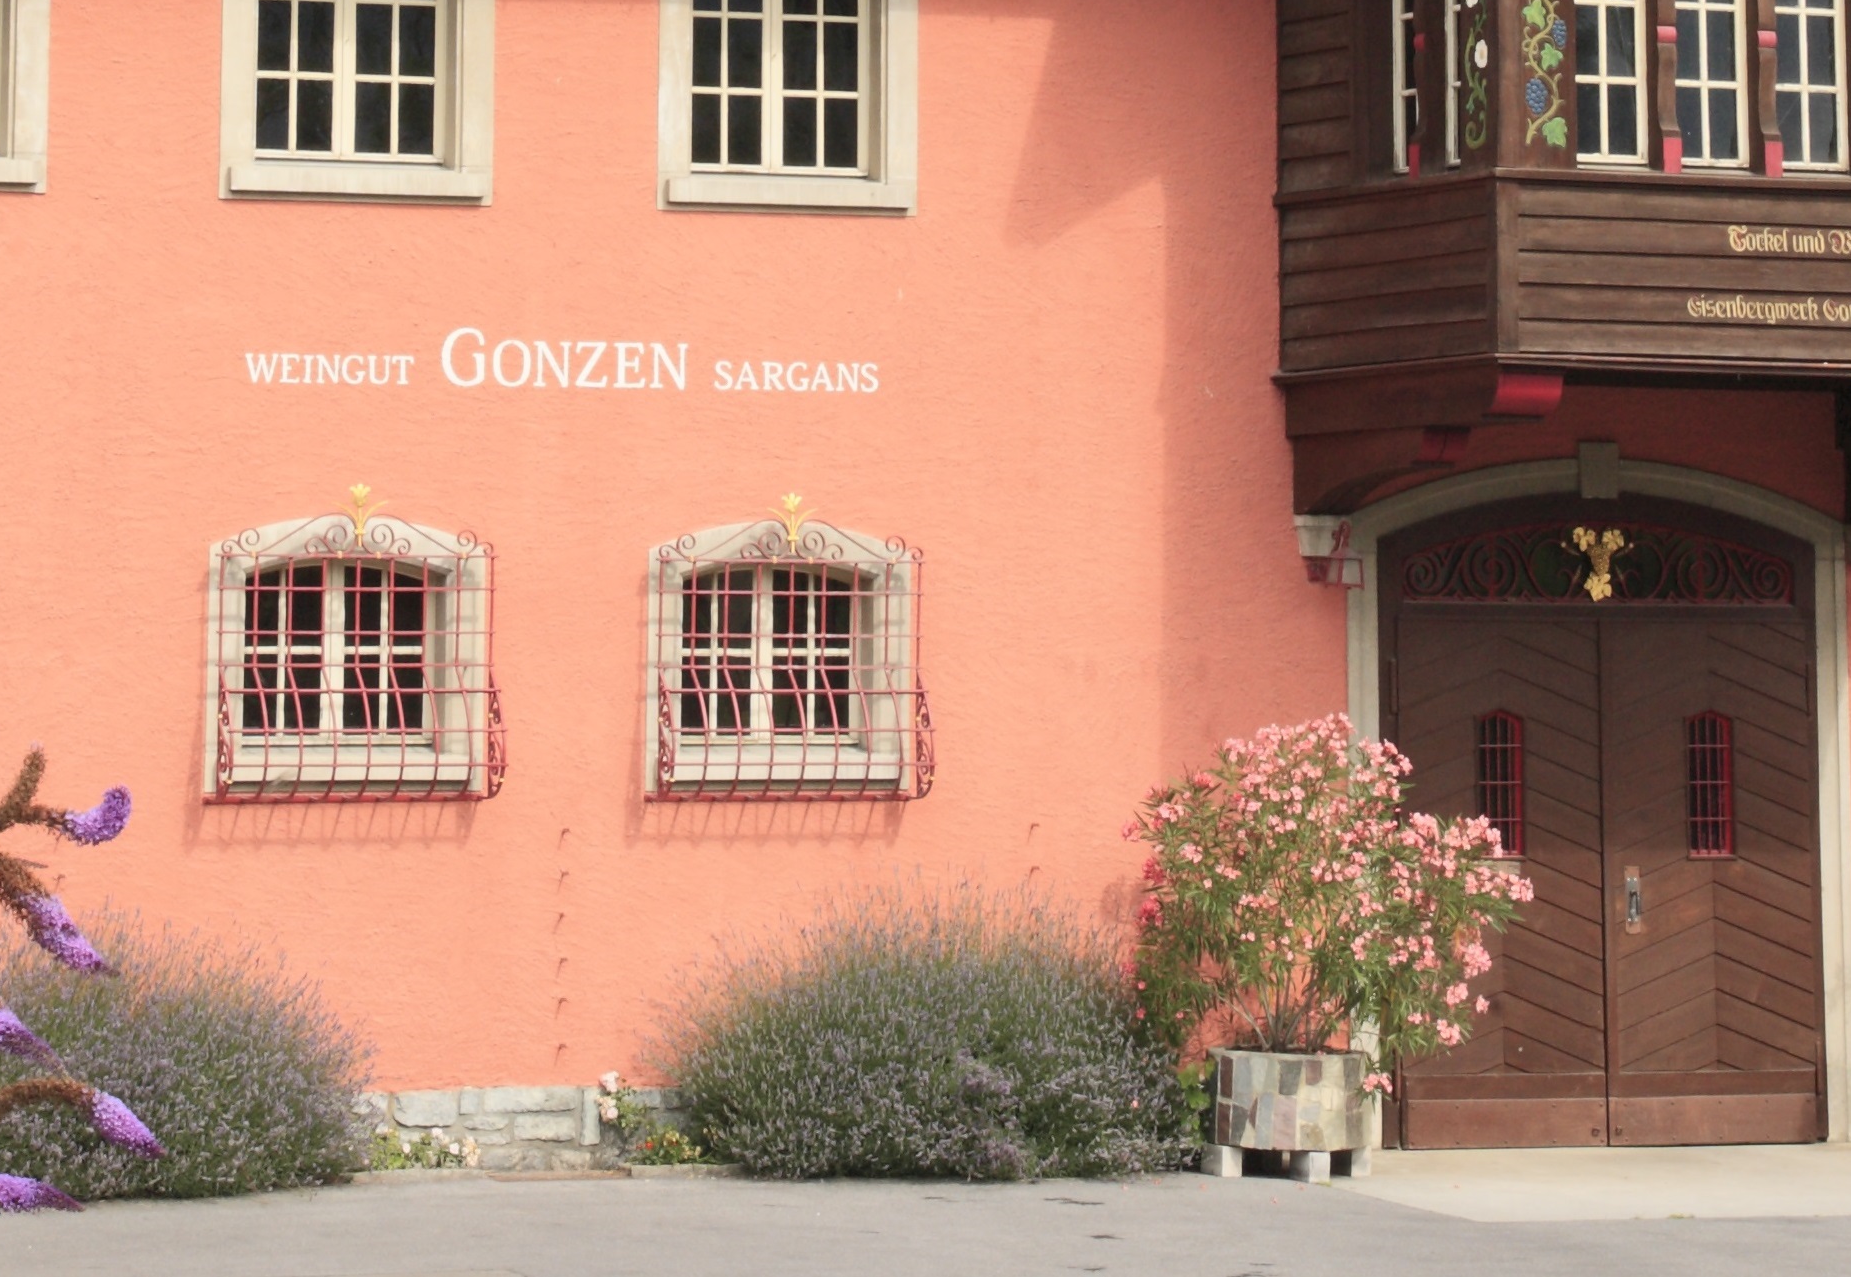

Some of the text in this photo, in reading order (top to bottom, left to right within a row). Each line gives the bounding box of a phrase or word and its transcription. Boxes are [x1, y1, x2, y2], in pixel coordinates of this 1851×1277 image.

[1792, 230, 1825, 253] und
[1687, 294, 1819, 324] Eisenbergwerk
[245, 326, 880, 393] WEINGUT GONZEN SARGANS
